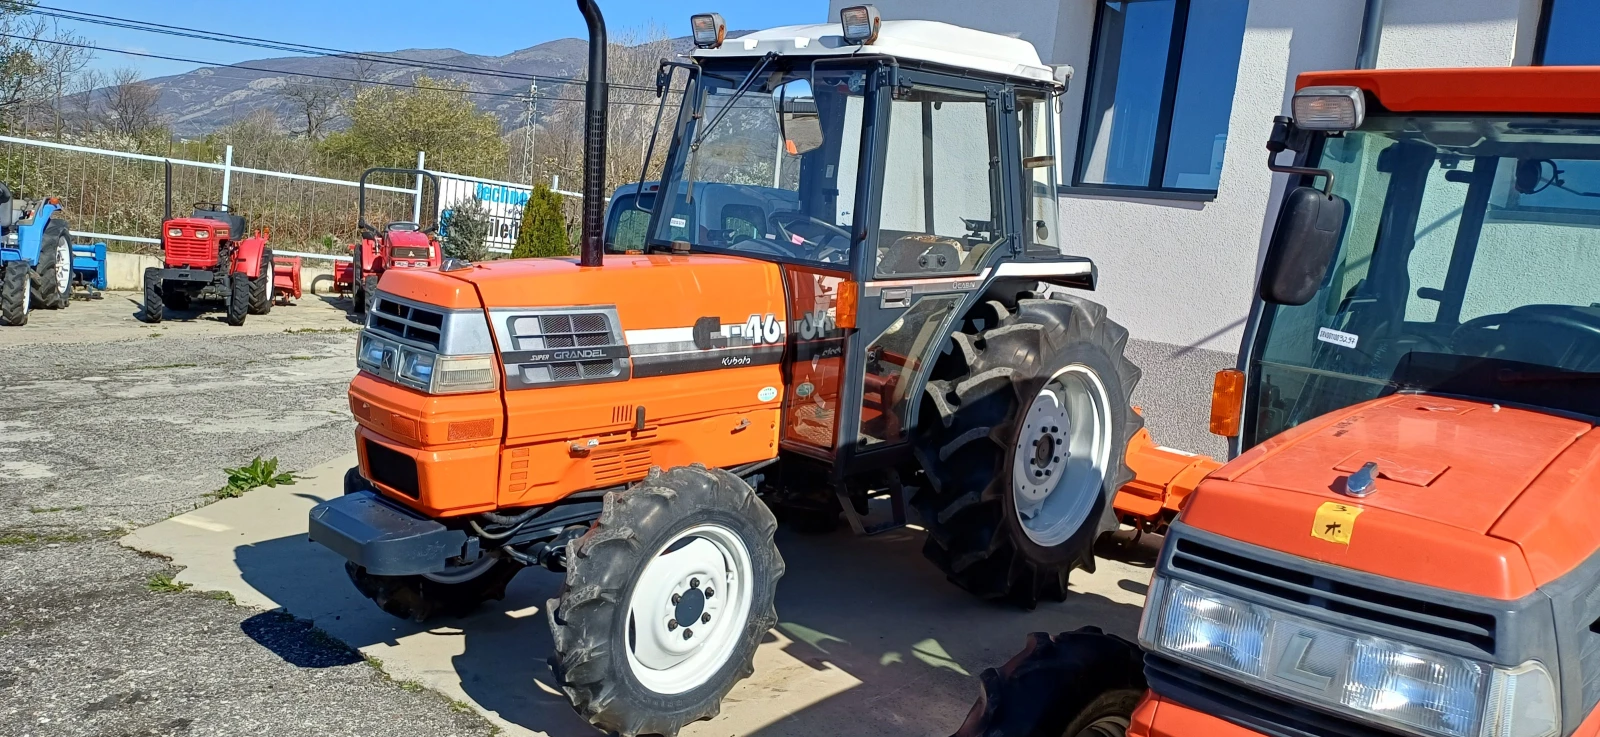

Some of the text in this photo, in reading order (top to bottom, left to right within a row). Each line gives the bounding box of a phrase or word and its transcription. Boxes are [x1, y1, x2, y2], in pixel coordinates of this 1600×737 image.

[475, 182, 529, 206] techne
[381, 351, 392, 369] K
[553, 349, 607, 360] GRANDEL
[721, 356, 751, 366] Kubota
[1273, 633, 1332, 692] L
